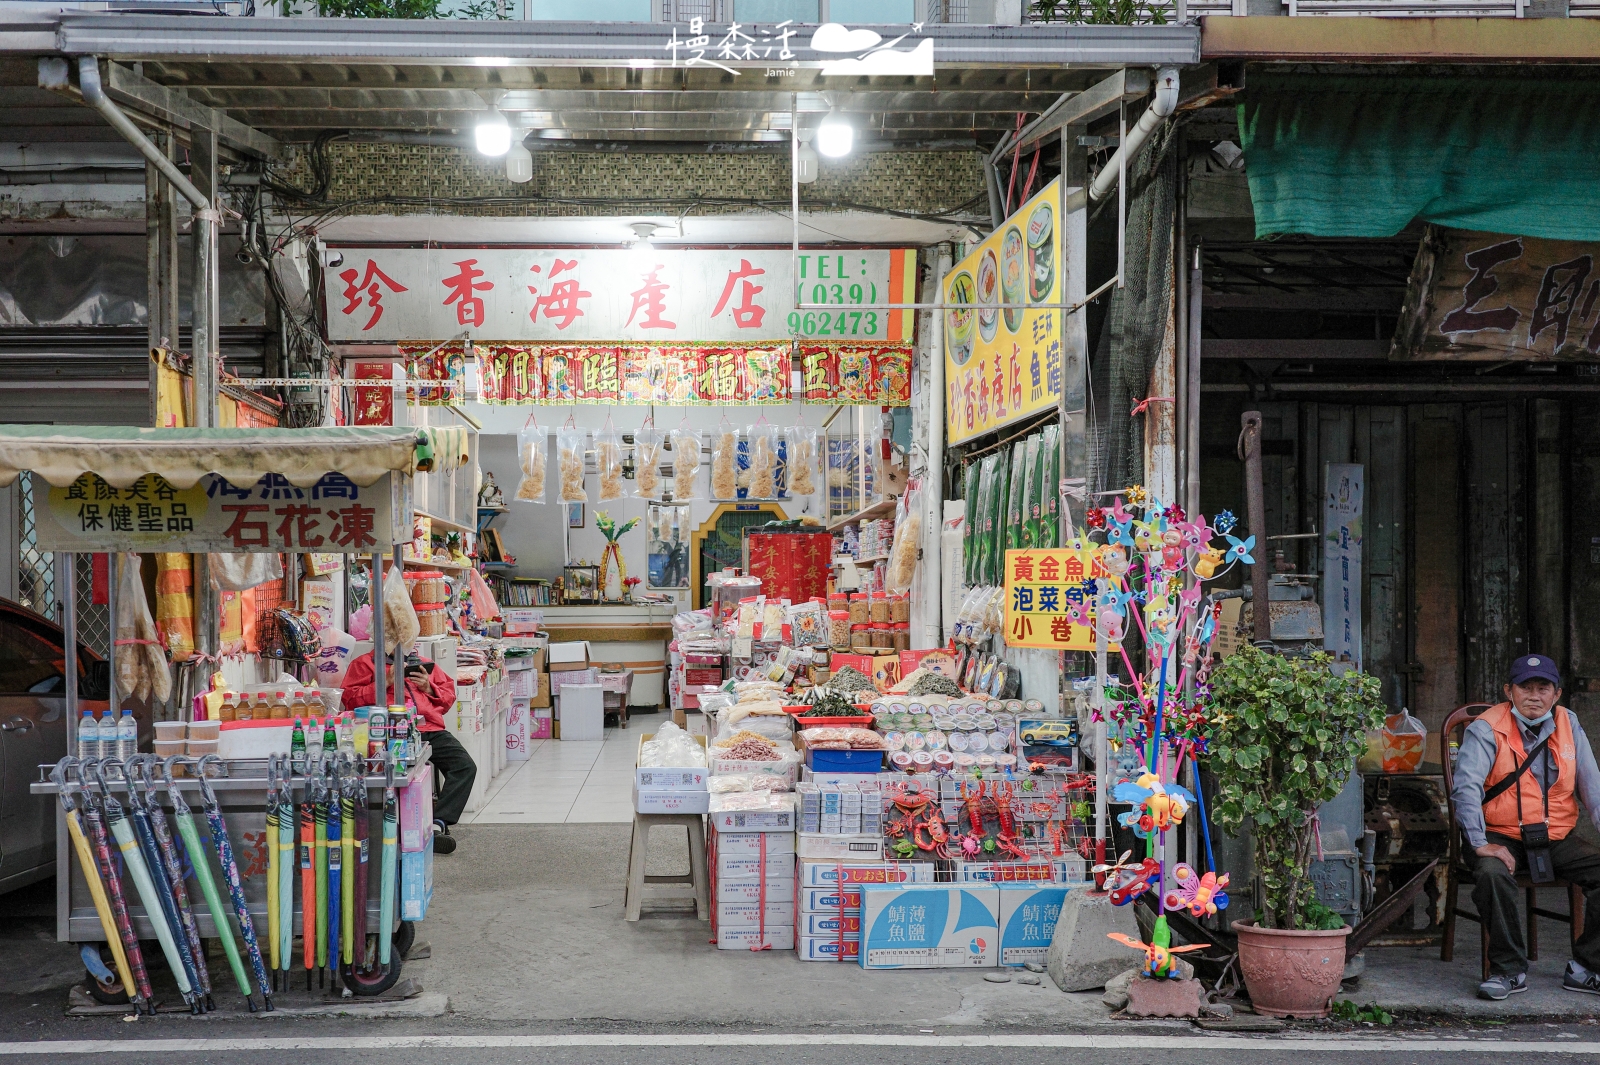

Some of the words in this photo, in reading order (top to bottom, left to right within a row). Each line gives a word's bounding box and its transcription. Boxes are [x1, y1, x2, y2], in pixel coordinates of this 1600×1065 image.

[798, 255, 867, 279] TEL:
[339, 258, 766, 331] 珍香海產店
[799, 281, 878, 305] (039)
[787, 311, 878, 336] 962473
[950, 343, 1022, 432] 珍香海產店
[78, 502, 194, 532] 保健聖品
[221, 503, 378, 548] 石花凍
[1013, 586, 1112, 613] 泡菜魚
